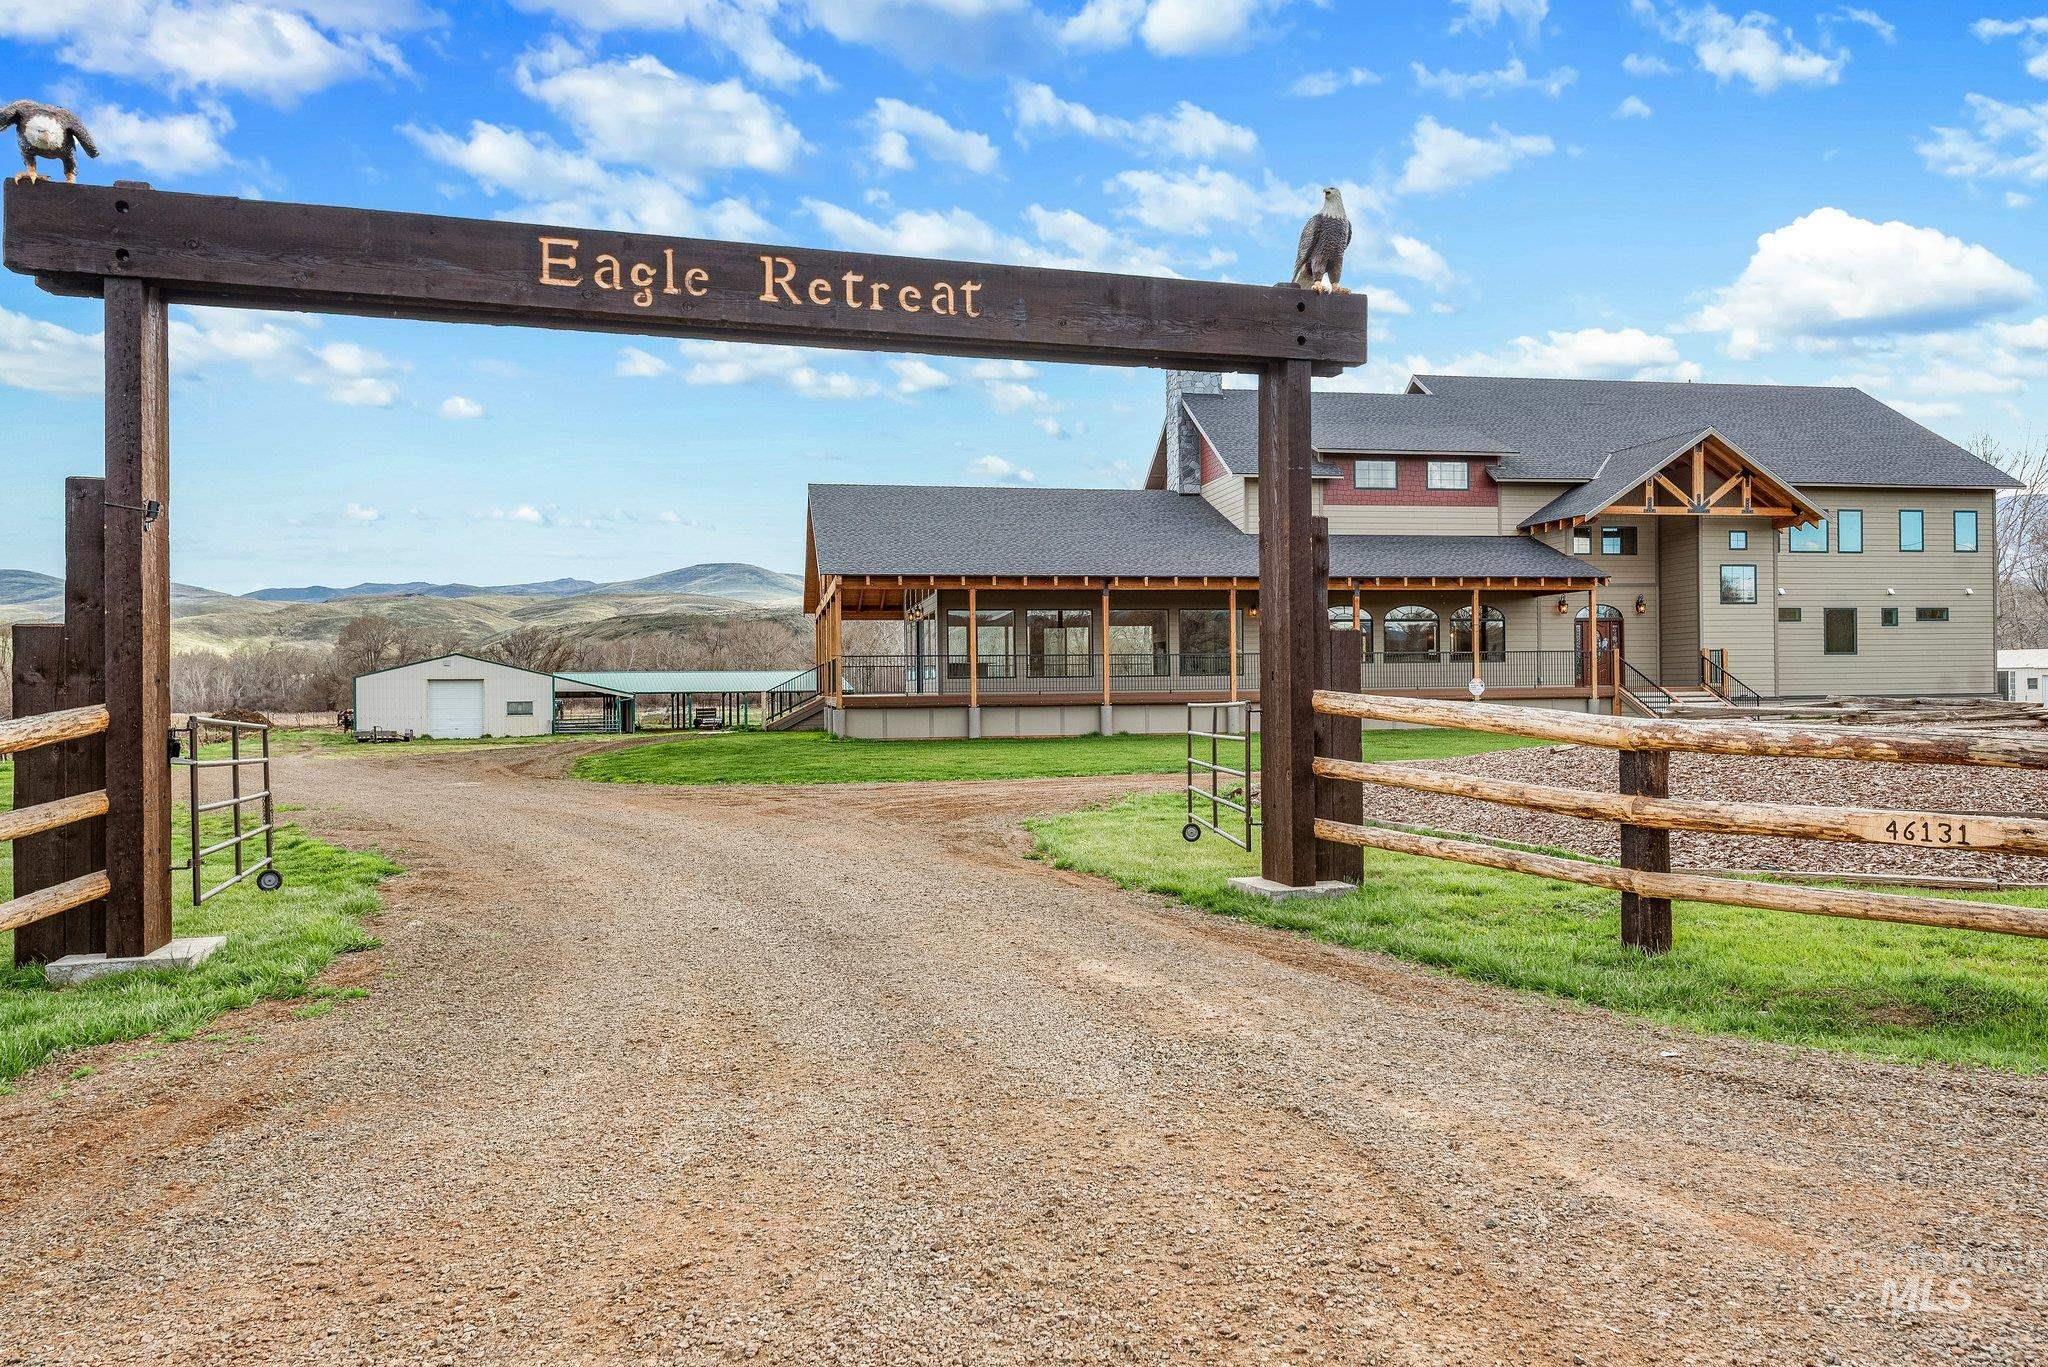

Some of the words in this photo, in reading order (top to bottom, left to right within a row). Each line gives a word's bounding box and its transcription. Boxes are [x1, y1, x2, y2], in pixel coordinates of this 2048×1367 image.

[538, 237, 709, 308] Eagle
[759, 256, 983, 318] Retreat
[1886, 820, 1970, 845] 46131
